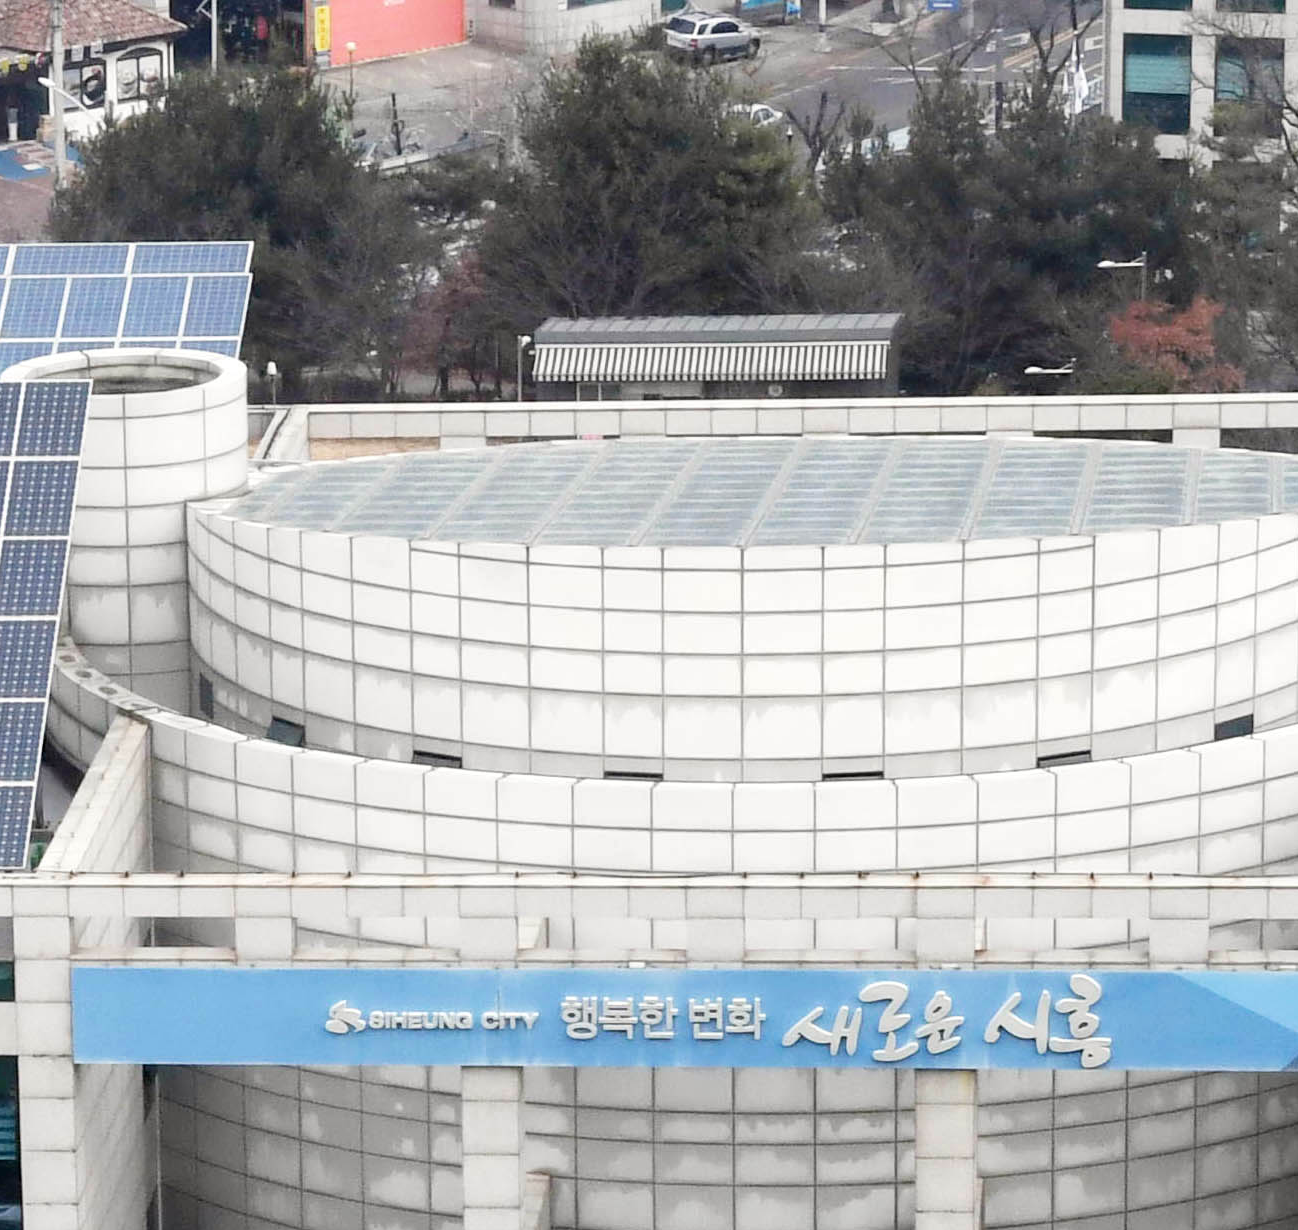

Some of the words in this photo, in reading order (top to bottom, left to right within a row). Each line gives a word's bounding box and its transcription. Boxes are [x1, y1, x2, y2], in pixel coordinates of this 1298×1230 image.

[368, 1010, 473, 1030] SIHEUNG
[480, 1010, 540, 1030] CITY
[561, 995, 679, 1041] 행복한
[688, 996, 767, 1041] 변화
[781, 980, 965, 1063] 새로운
[983, 973, 1113, 1069] 시흥
